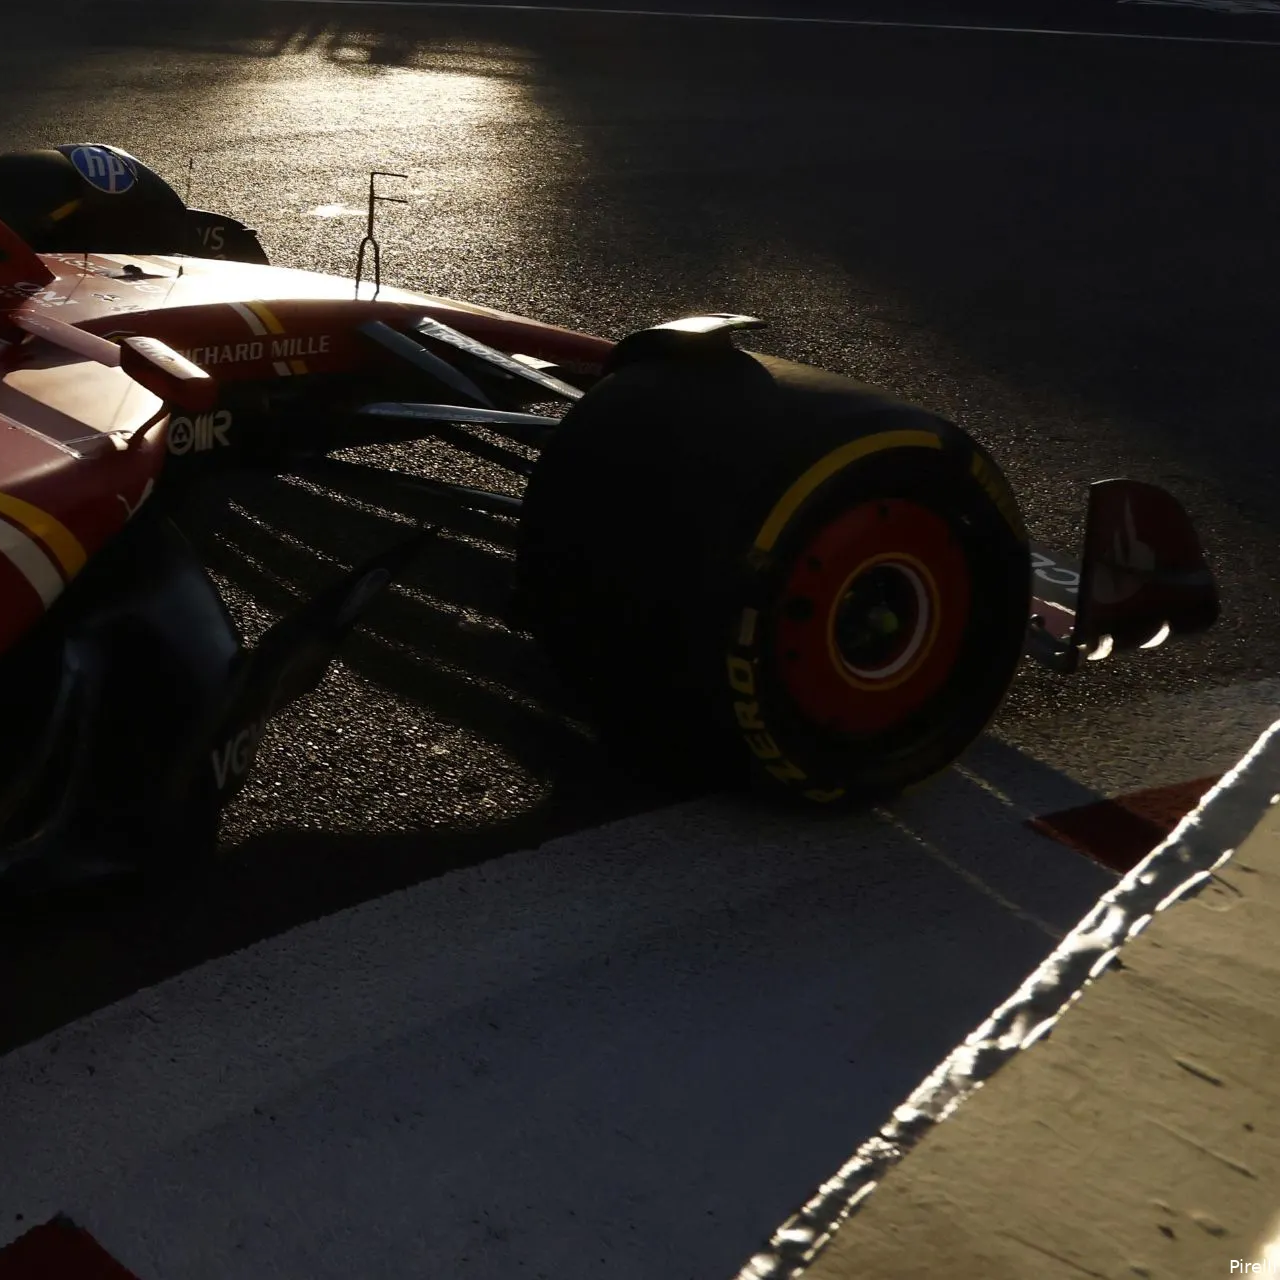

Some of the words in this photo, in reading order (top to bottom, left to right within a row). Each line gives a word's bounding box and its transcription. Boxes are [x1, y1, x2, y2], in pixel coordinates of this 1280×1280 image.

[83, 146, 125, 192] hp
[181, 341, 264, 367] ICHARD
[270, 334, 333, 359] MILLE
